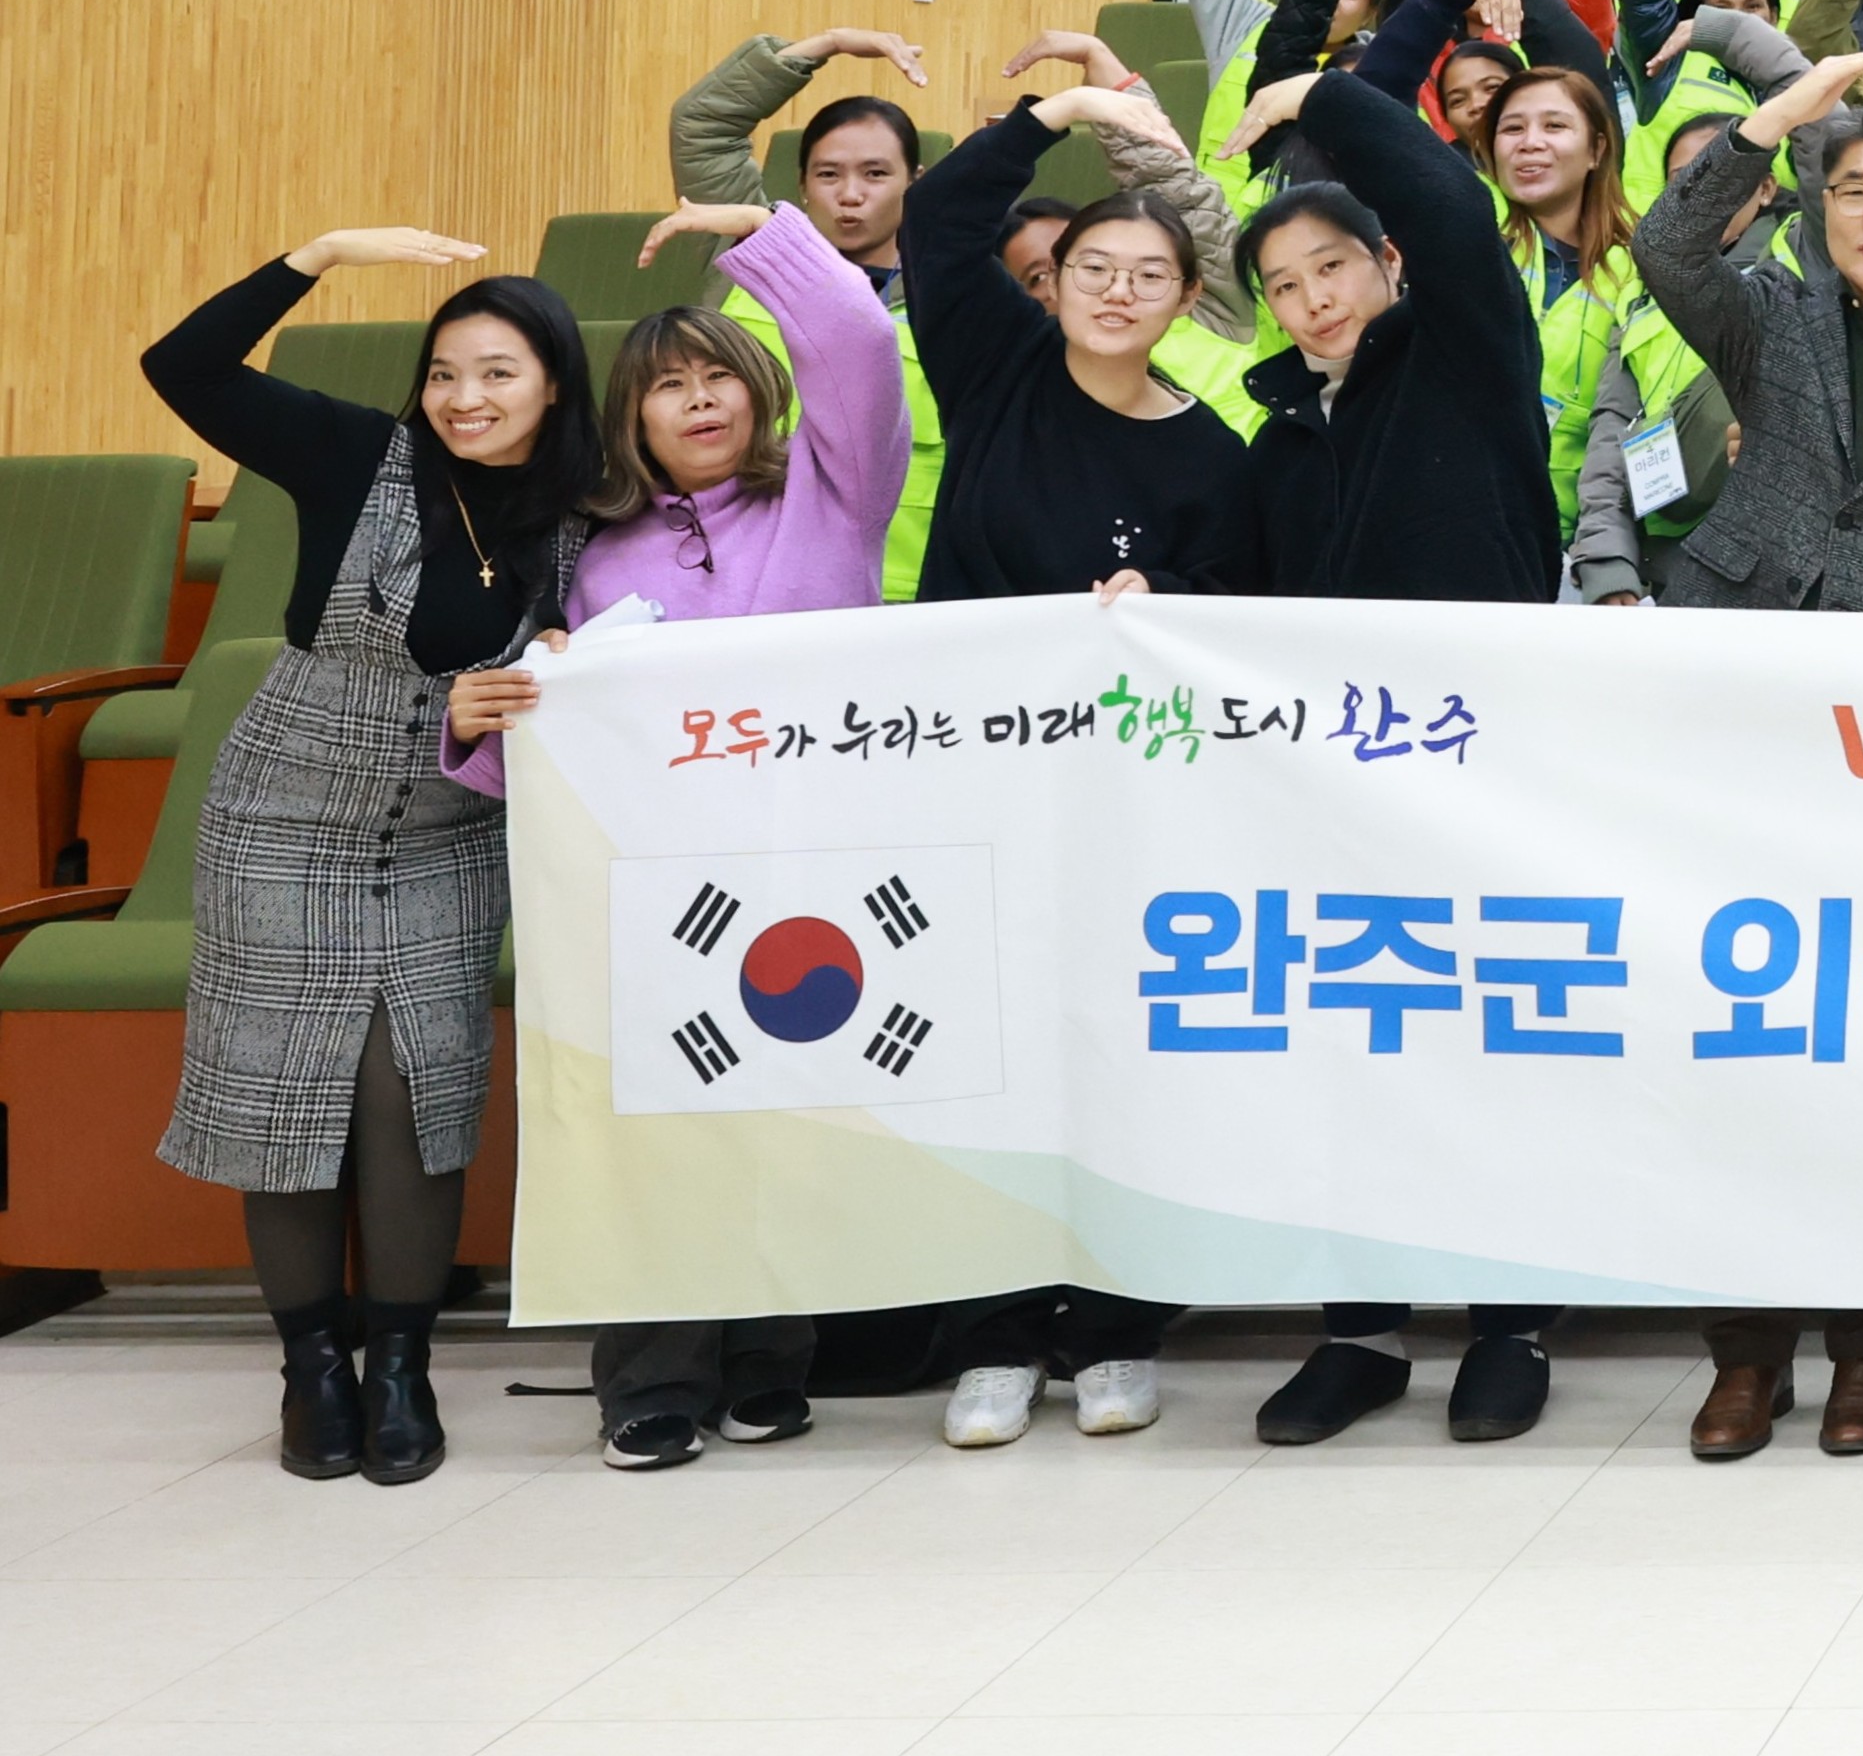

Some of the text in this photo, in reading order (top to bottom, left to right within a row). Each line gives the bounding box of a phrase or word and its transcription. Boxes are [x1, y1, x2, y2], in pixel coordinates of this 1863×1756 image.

[668, 708, 817, 768] 모두가
[832, 701, 963, 761] 누리는
[1326, 681, 1479, 765] 완주
[1138, 889, 1630, 1058] 완주군
